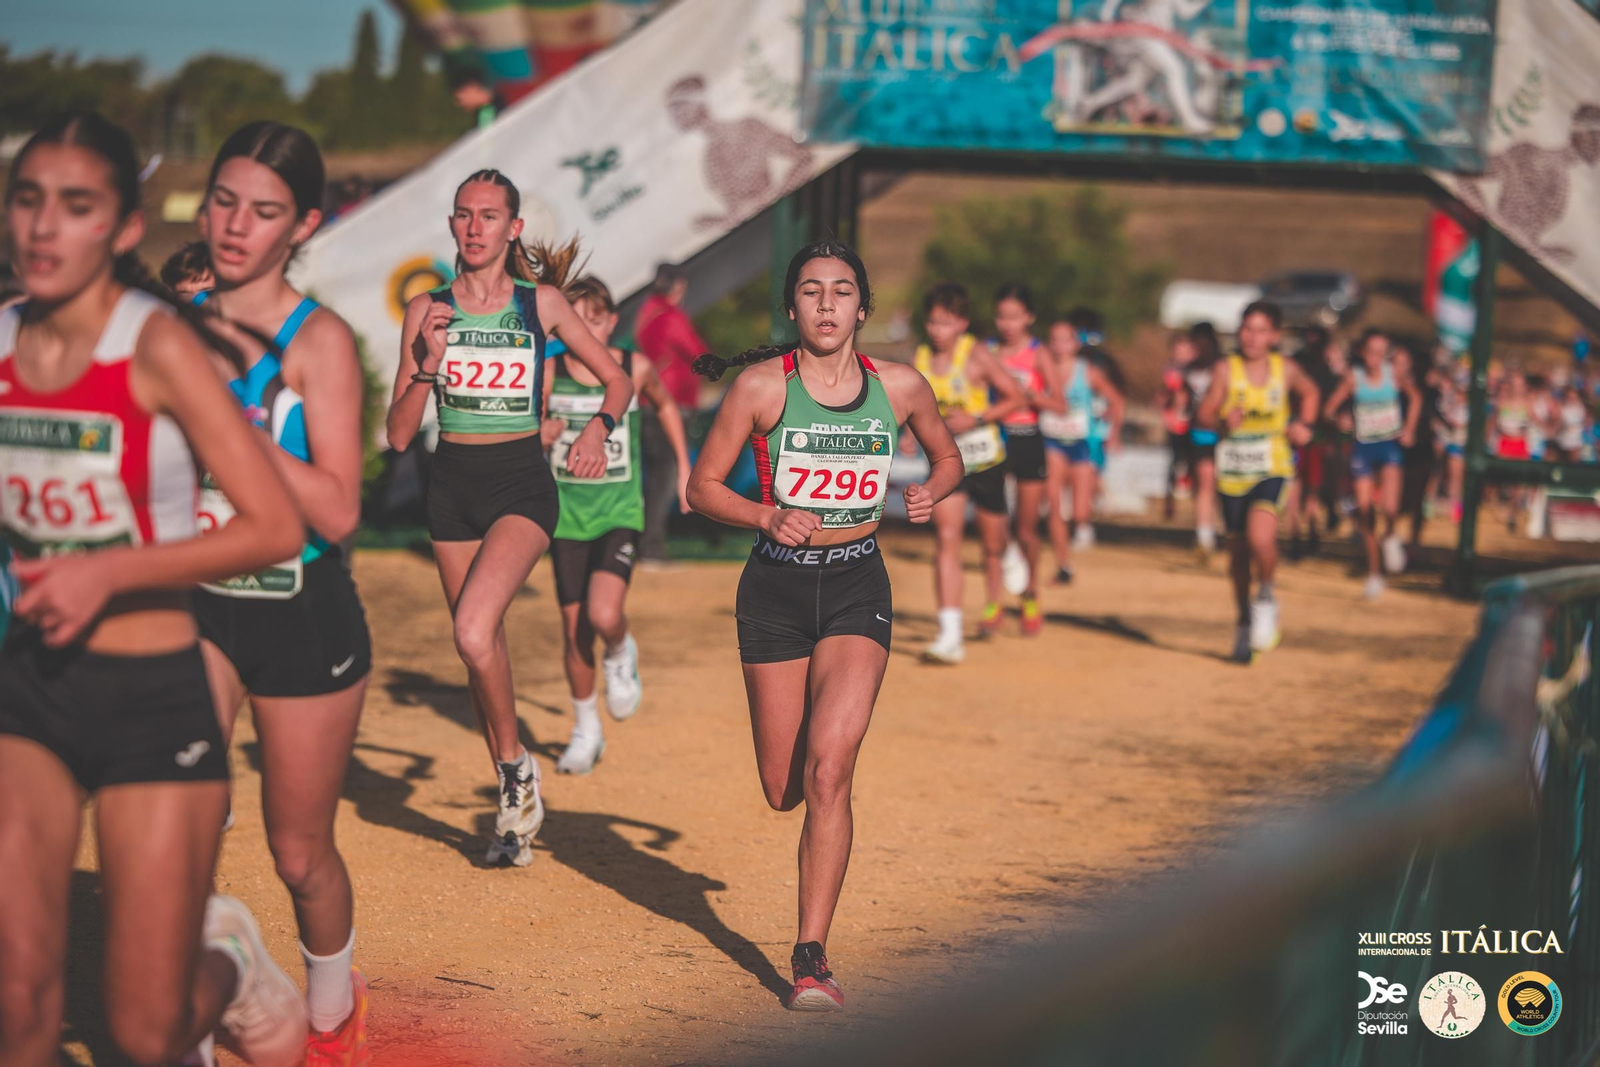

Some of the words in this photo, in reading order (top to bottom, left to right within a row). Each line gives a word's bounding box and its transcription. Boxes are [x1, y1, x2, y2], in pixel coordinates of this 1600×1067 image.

[447, 361, 526, 389] 5222
[815, 435, 865, 448] ITÁLICA
[788, 467, 879, 500] 7296
[761, 542, 822, 565] NIKE
[825, 538, 875, 564] PRO
